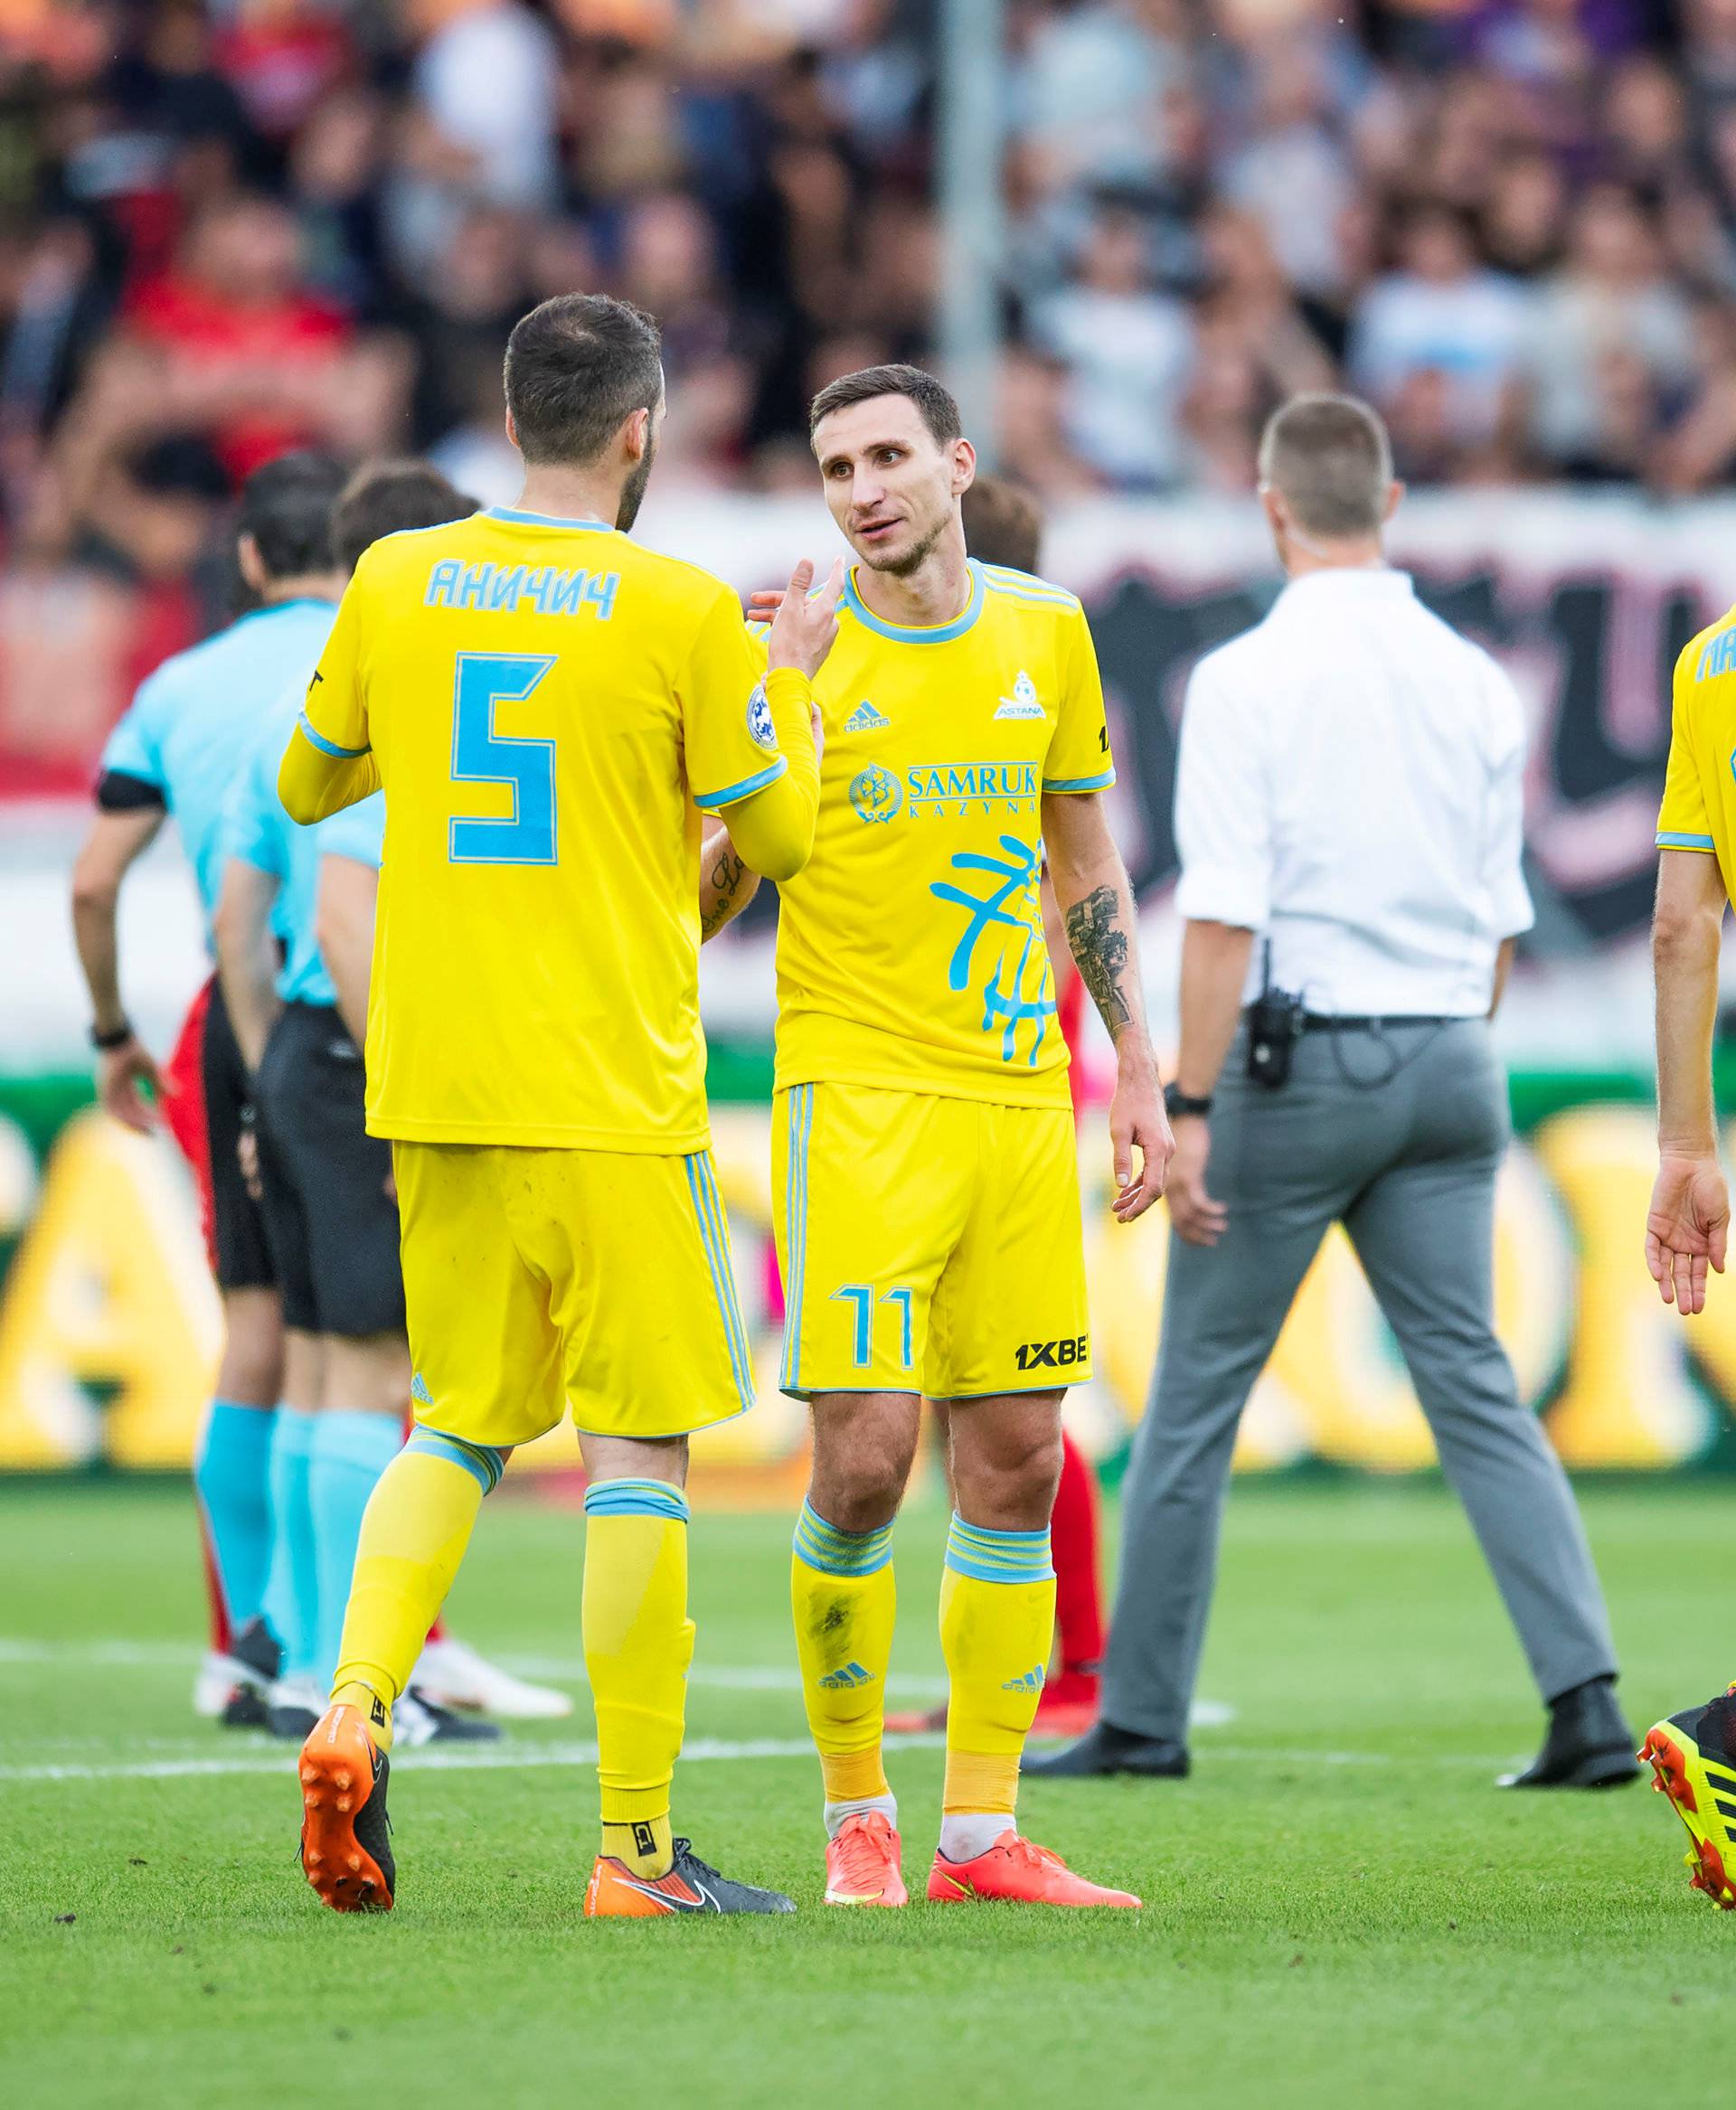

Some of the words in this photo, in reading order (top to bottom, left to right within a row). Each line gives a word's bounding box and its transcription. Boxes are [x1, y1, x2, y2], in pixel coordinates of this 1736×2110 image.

[424, 559, 621, 620] АНИЧИЧ
[844, 718, 890, 732] adidas
[997, 706, 1043, 716] ASTANA
[448, 651, 559, 866] 5
[908, 767, 1038, 798] SAMRUK
[909, 800, 1036, 819] KAZYNA
[828, 1284, 914, 1371] 11
[1015, 1333, 1089, 1371] 1XBE
